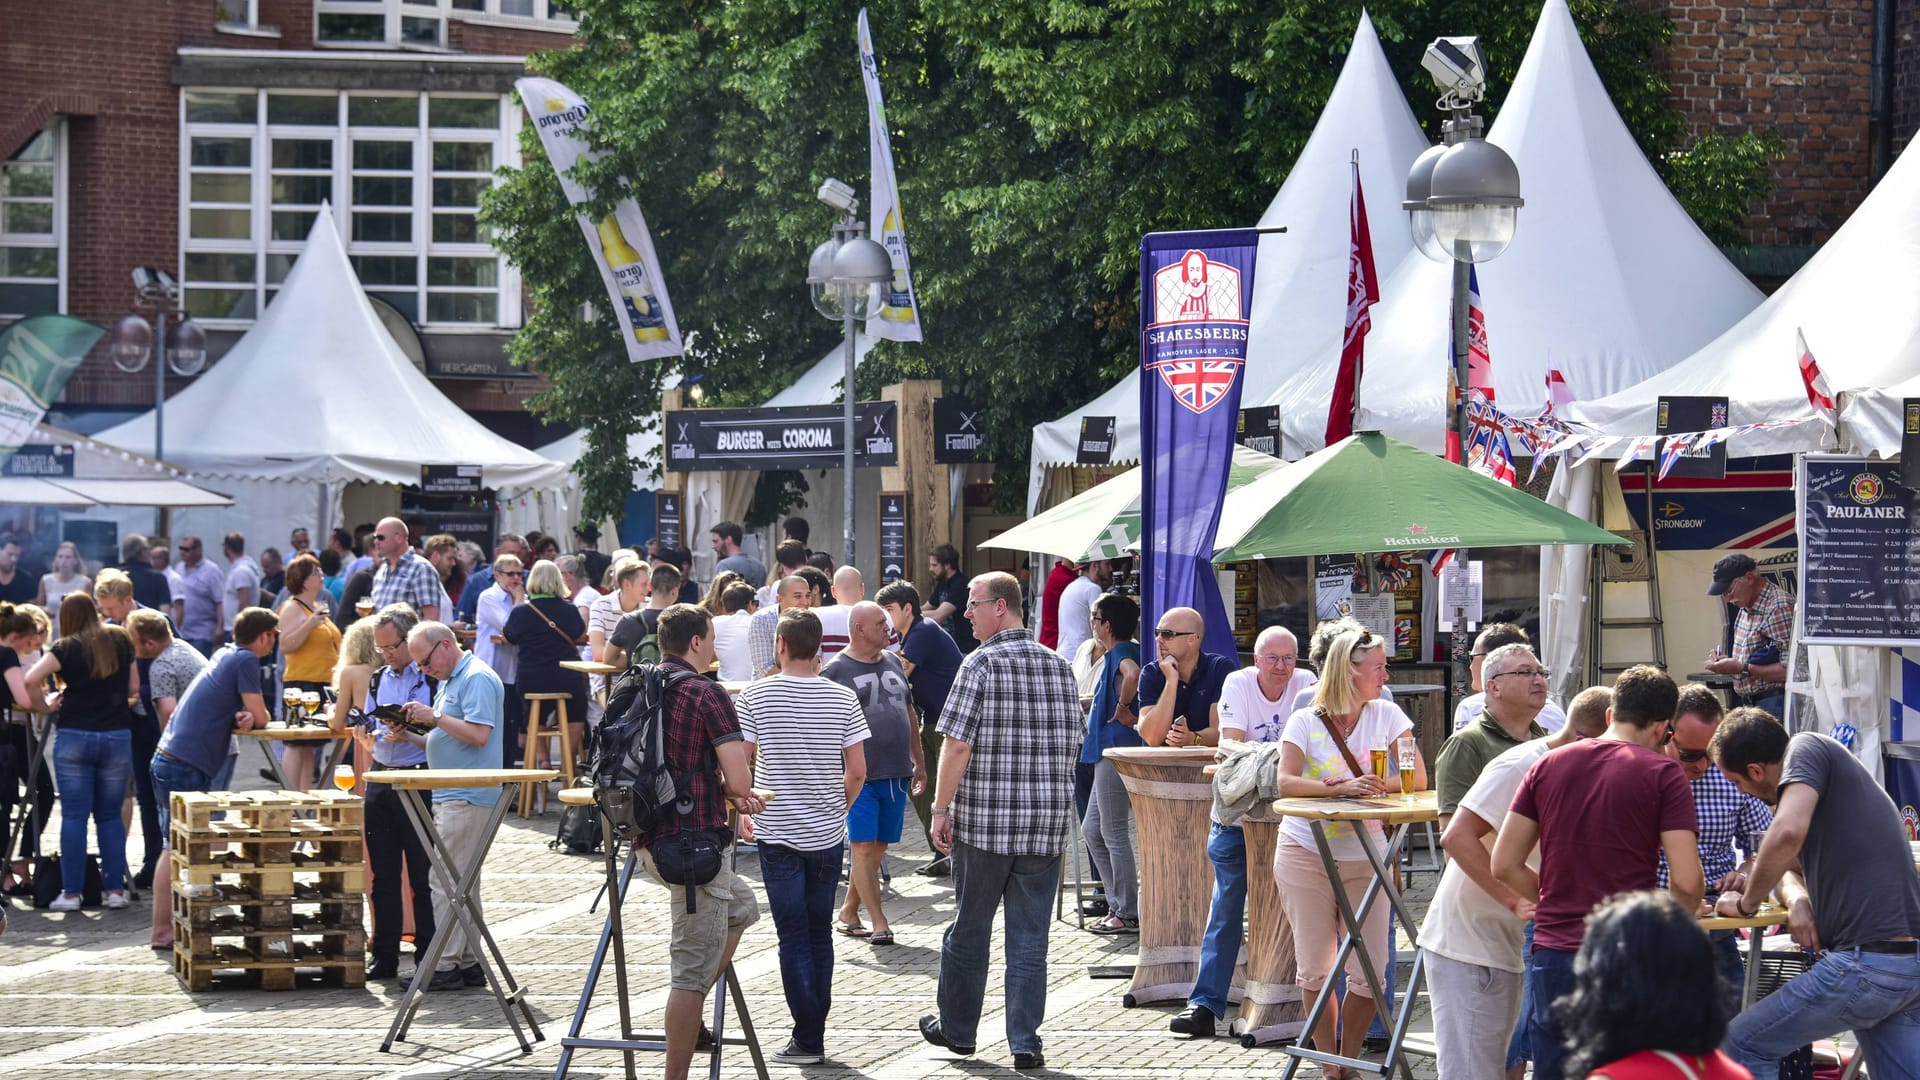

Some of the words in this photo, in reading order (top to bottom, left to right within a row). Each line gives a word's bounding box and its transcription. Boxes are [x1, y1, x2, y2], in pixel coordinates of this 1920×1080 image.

[1149, 327, 1247, 345] SHAKESBEERS
[717, 430, 764, 450] BURGER
[782, 428, 832, 449] CORONA
[1826, 505, 1906, 519] PAULANER
[1655, 518, 1703, 530] STRONGBOW
[1384, 536, 1460, 546] Heineken
[852, 670, 908, 715] 79
